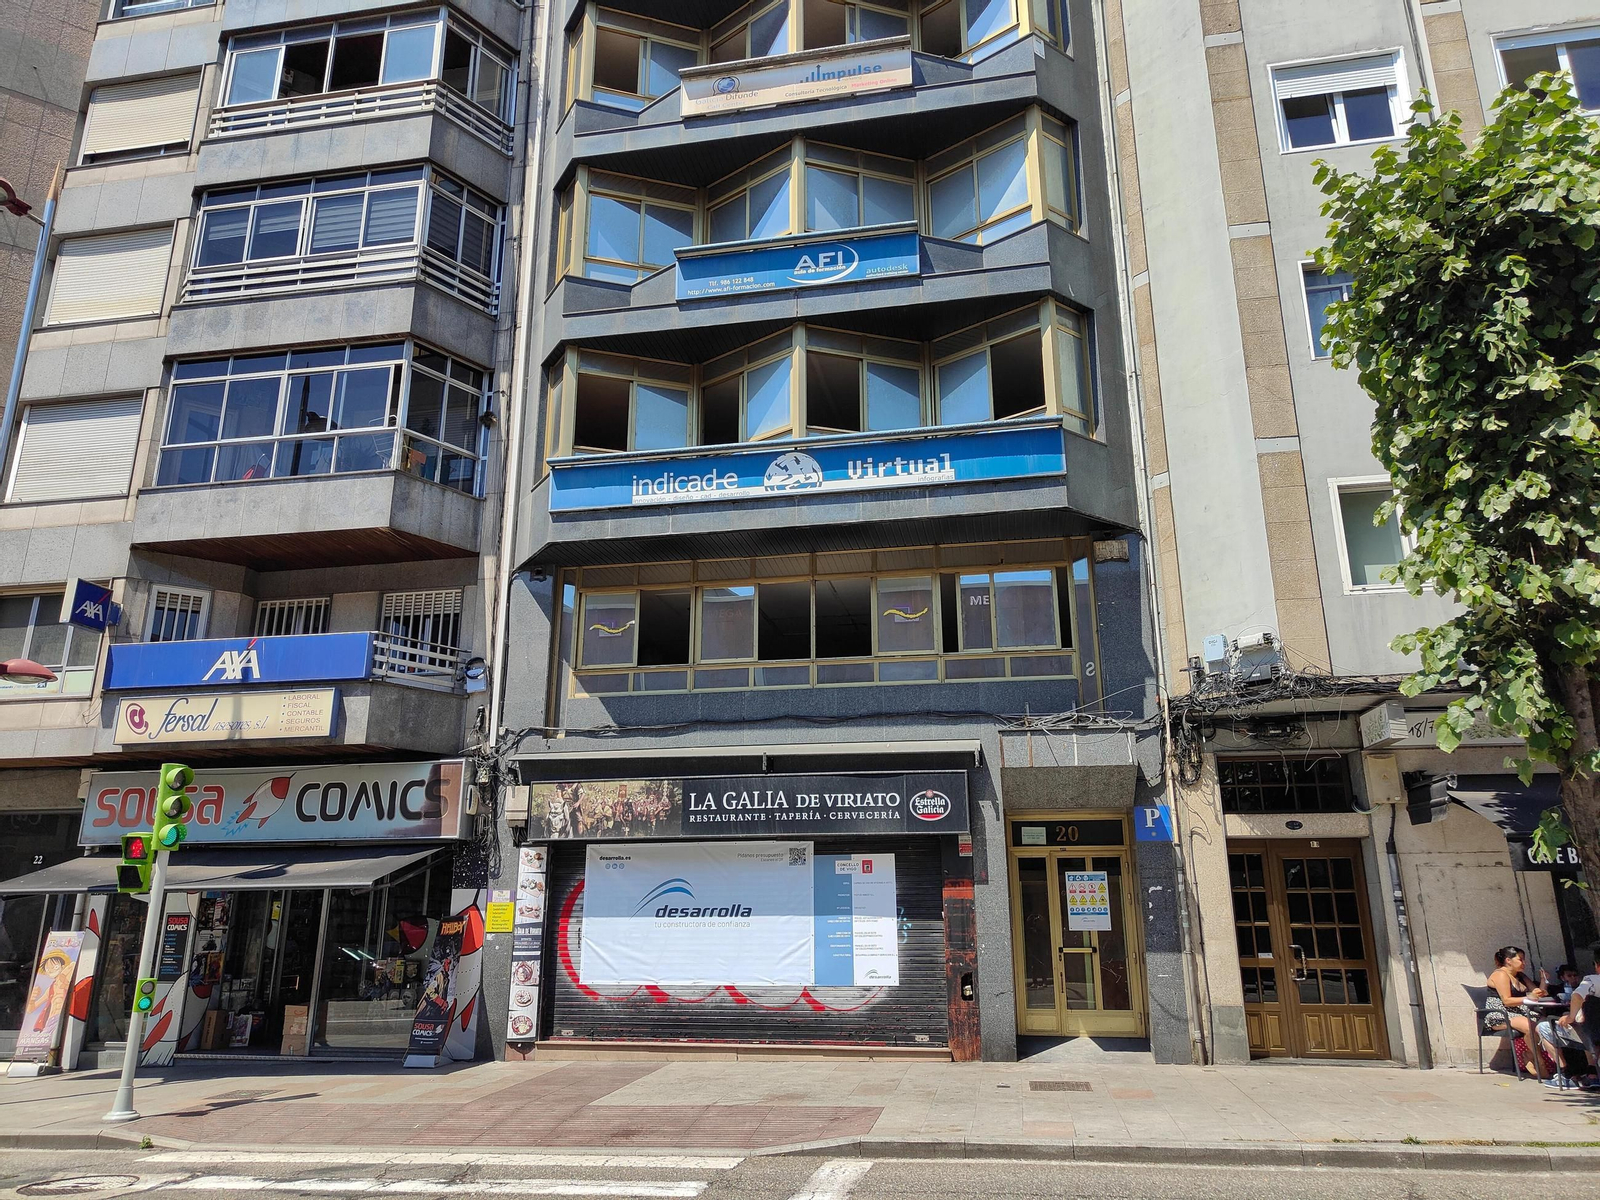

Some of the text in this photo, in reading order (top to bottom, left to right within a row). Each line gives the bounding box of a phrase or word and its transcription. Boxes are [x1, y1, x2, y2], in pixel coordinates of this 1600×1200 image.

[851, 80, 878, 88] Marketing
[725, 90, 759, 101] Difunde
[794, 250, 843, 270] AFI
[866, 263, 908, 274] autodesk
[848, 453, 952, 480] Virtual
[718, 490, 750, 498] desarrollo
[75, 600, 103, 622] AXA
[202, 648, 261, 681] AXA
[288, 693, 320, 701] LABORAL
[148, 697, 218, 740] fersal
[287, 709, 324, 717] CONTABLE
[284, 725, 324, 733] MERCANTIL
[295, 779, 451, 821] COMICS
[689, 791, 900, 811] LA GALIA DE VIRIATO
[914, 796, 946, 806] Estrella
[689, 808, 900, 823] RESTAURANTE TAPERÍA CERVECERÍA
[916, 805, 945, 814] Galicia
[1143, 808, 1160, 828] P
[1055, 825, 1079, 842] 20
[33, 855, 43, 864] 22
[1527, 847, 1582, 864] CAE B
[655, 904, 753, 918] desarrolla
[654, 920, 751, 928] tu constructora de confianza
